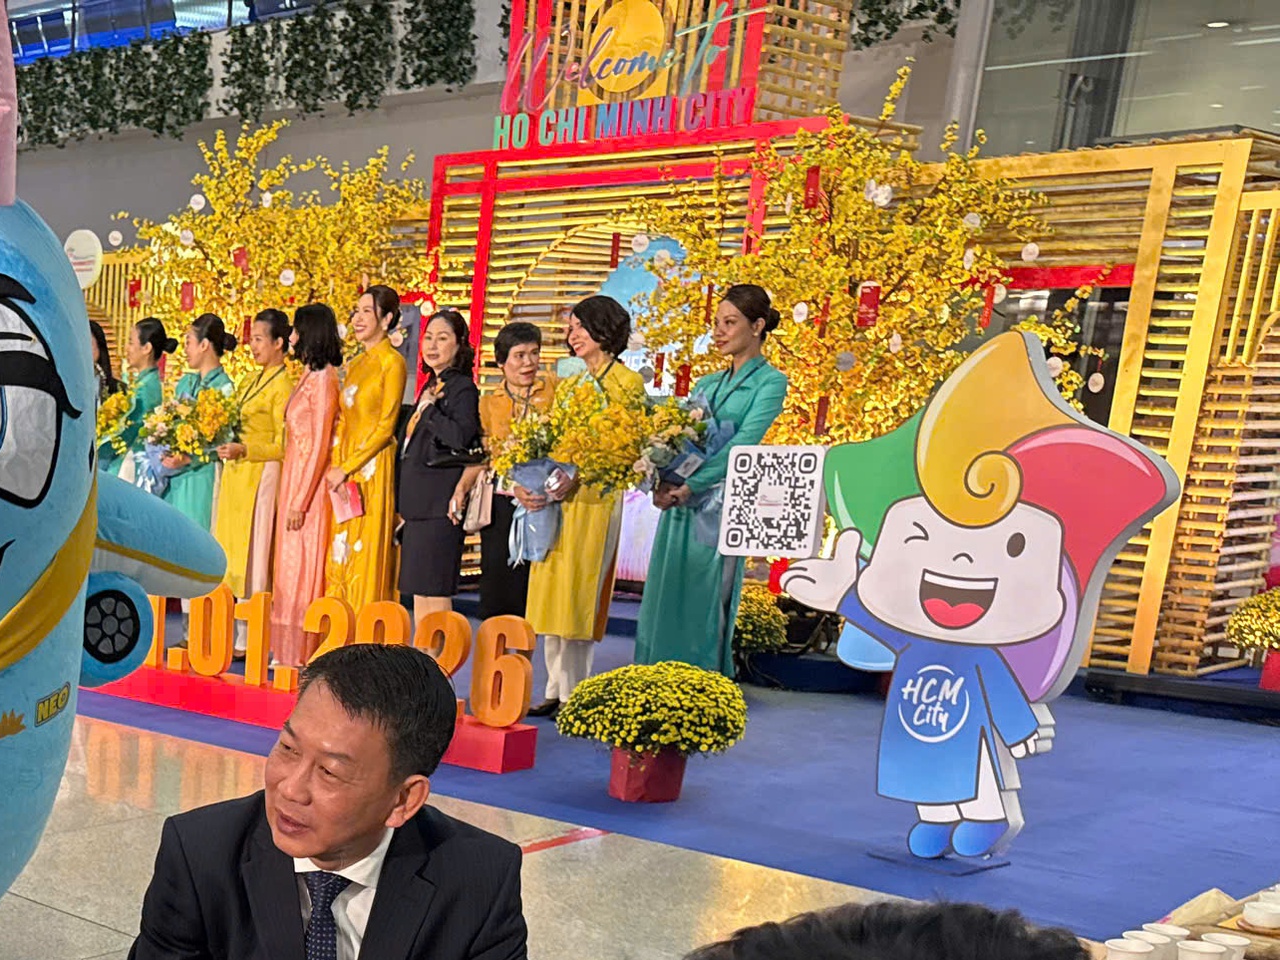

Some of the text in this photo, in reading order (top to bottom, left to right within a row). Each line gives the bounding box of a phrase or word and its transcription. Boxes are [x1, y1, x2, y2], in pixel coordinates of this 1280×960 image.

[500, 3, 774, 113] Welcome to
[493, 86, 757, 151] HO CHI MINH CITY
[35, 683, 70, 725] NEO
[901, 676, 965, 706] HCM
[912, 701, 949, 733] City
